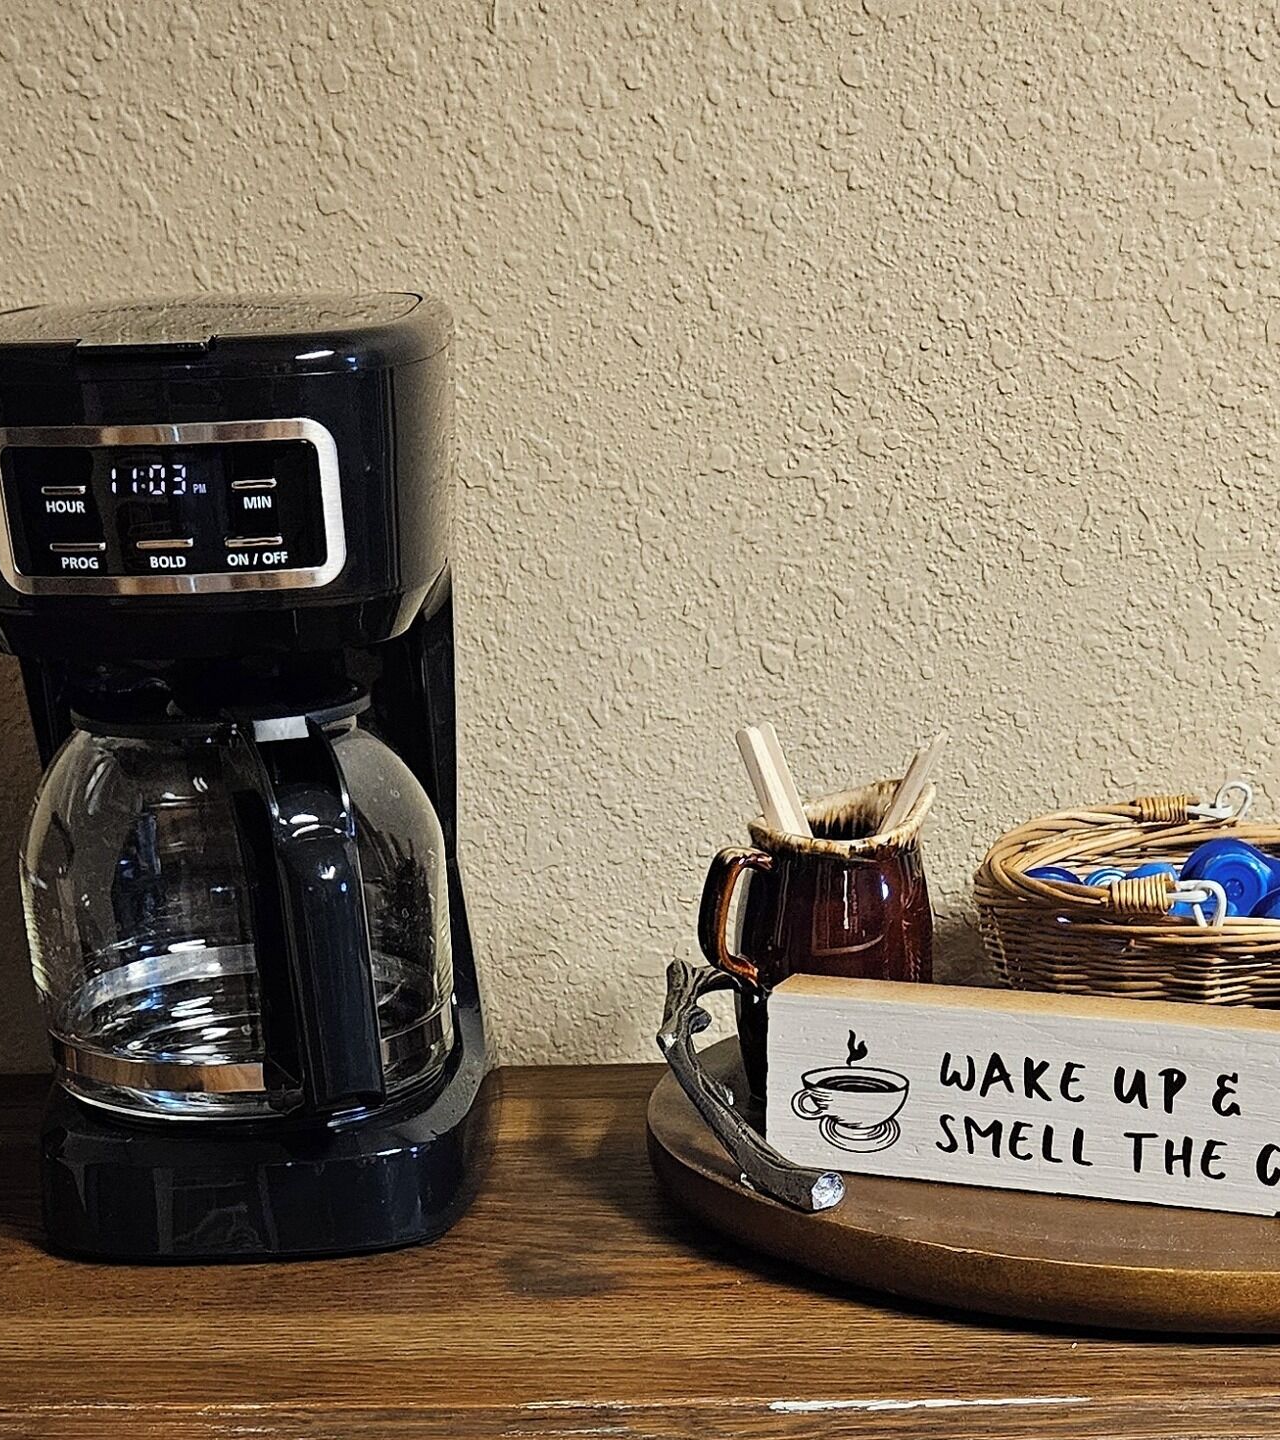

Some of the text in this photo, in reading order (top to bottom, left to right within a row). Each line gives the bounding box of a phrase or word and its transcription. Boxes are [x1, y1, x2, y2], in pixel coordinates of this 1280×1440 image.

[110, 463, 208, 496] 11:03 PM
[45, 500, 86, 514] HOUR
[243, 495, 272, 510] MIN
[61, 556, 100, 570] PROG
[149, 555, 187, 569] BOLD
[226, 554, 250, 567] ON
[262, 551, 289, 566] OFF
[939, 1051, 1242, 1117] WAKE UP &
[935, 1114, 1094, 1168] SMELL
[1123, 1131, 1228, 1181] THE
